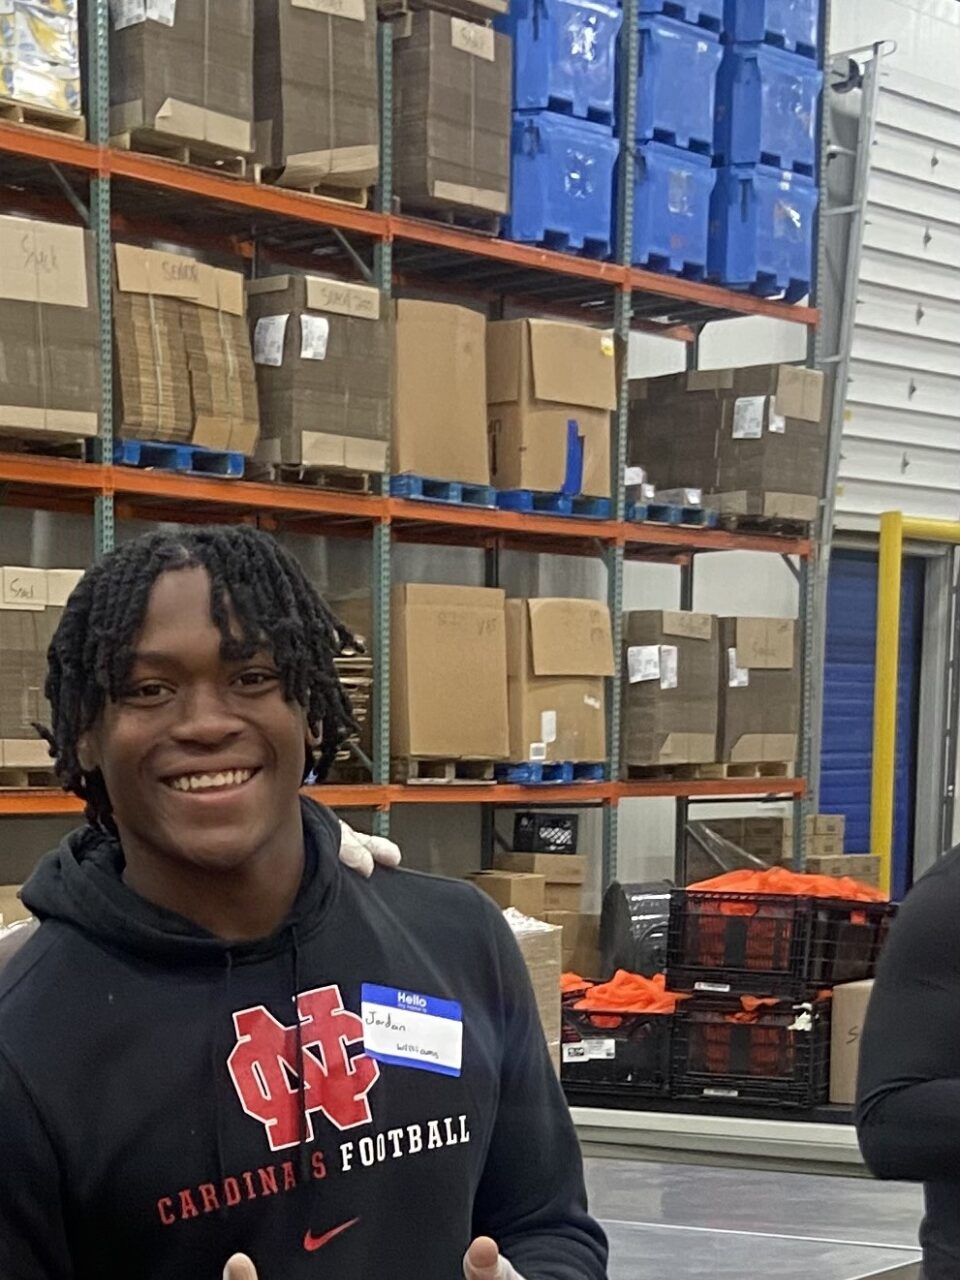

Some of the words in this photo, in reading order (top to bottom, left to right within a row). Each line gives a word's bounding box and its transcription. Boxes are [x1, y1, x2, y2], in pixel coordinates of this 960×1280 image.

[397, 991, 428, 1008] Hello
[365, 1010, 407, 1032] Jordan
[156, 1151, 328, 1225] CARDINAS
[340, 1115, 471, 1172] FOOTBALL
